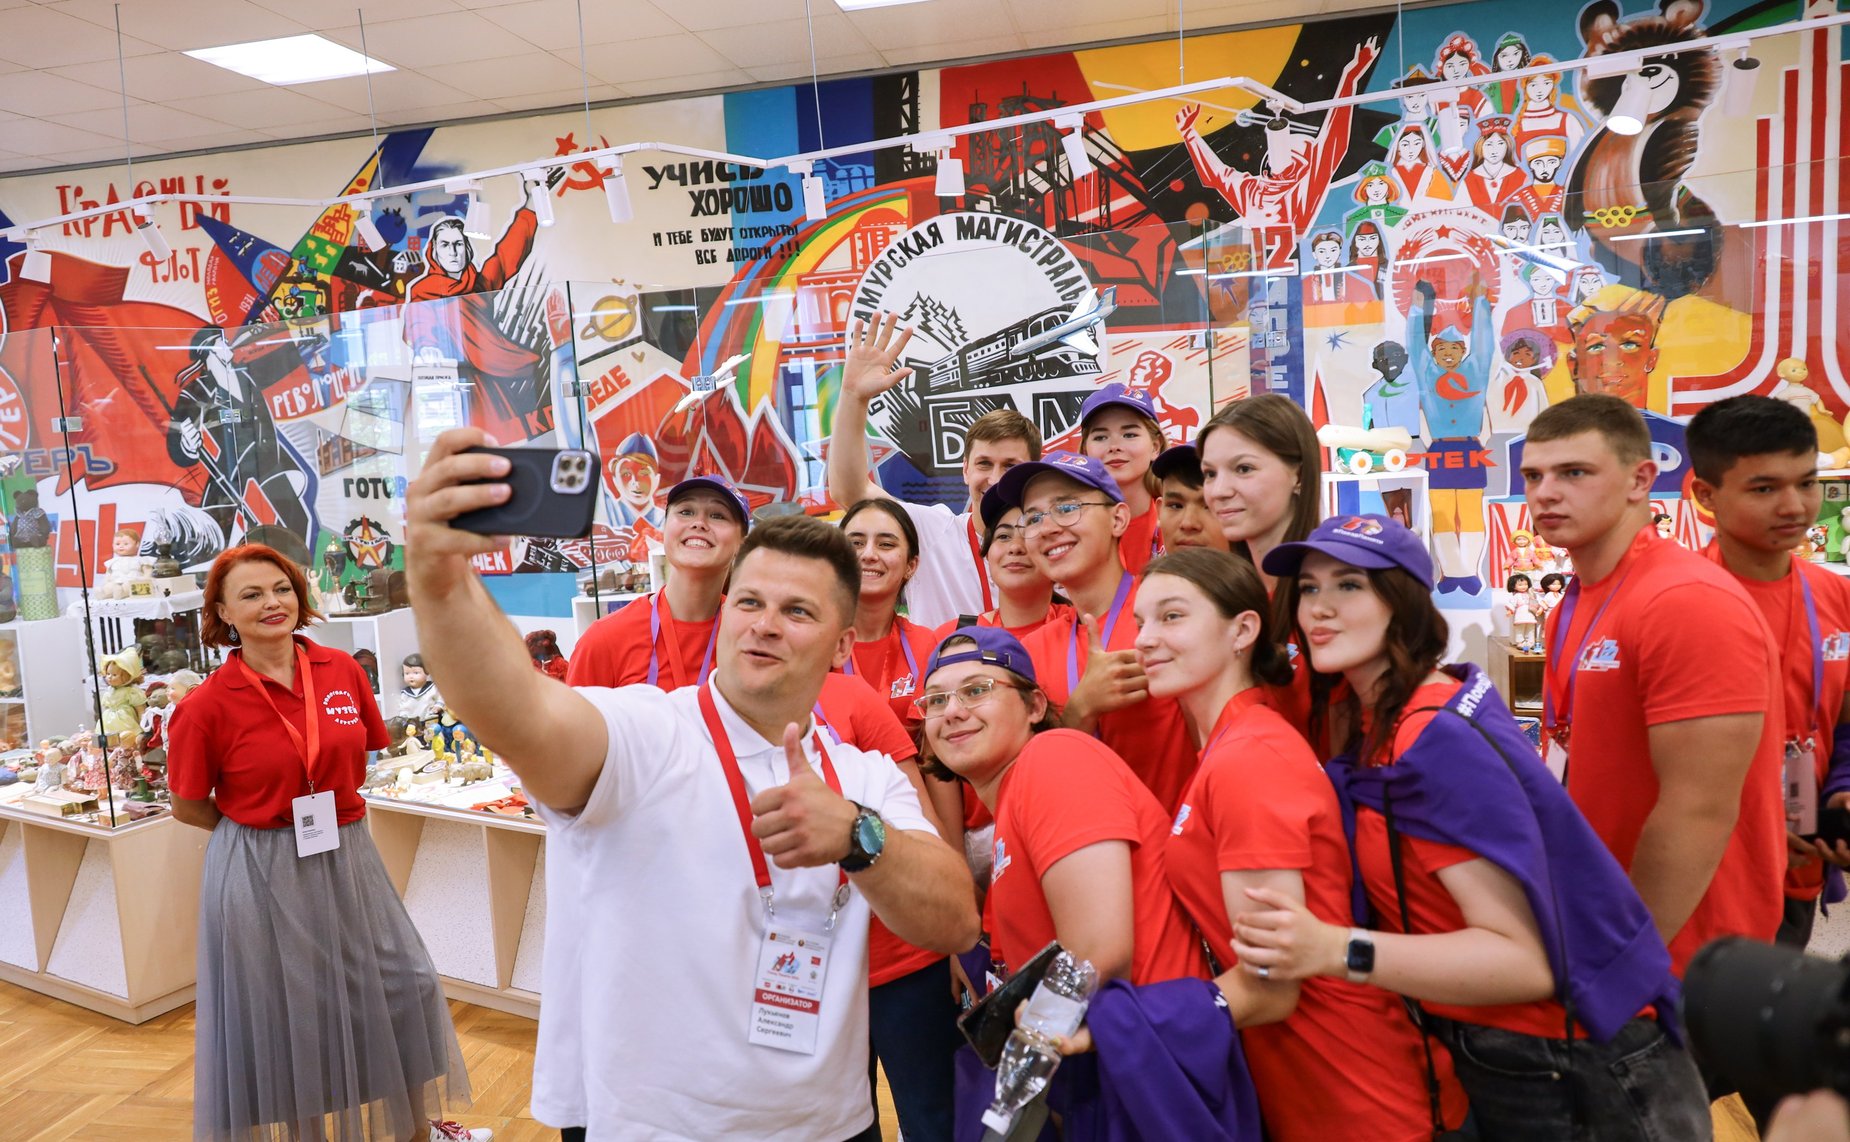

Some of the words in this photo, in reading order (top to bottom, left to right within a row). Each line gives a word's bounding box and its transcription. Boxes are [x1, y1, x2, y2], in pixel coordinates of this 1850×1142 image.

[688, 182, 793, 217] ХОРОШО
[653, 232, 662, 246] И
[666, 230, 693, 245] ТЕБЕ
[701, 226, 734, 242] БУДУТ
[740, 224, 799, 240] ОТКРЫТЫ
[695, 249, 717, 265] ВСЕ
[726, 246, 773, 263] ДОРОГИ
[956, 216, 1087, 305] МАГИСТРАЛЬ
[343, 476, 407, 499] ГОТОВ
[762, 993, 813, 1009] ОРГАНИЗАТОР
